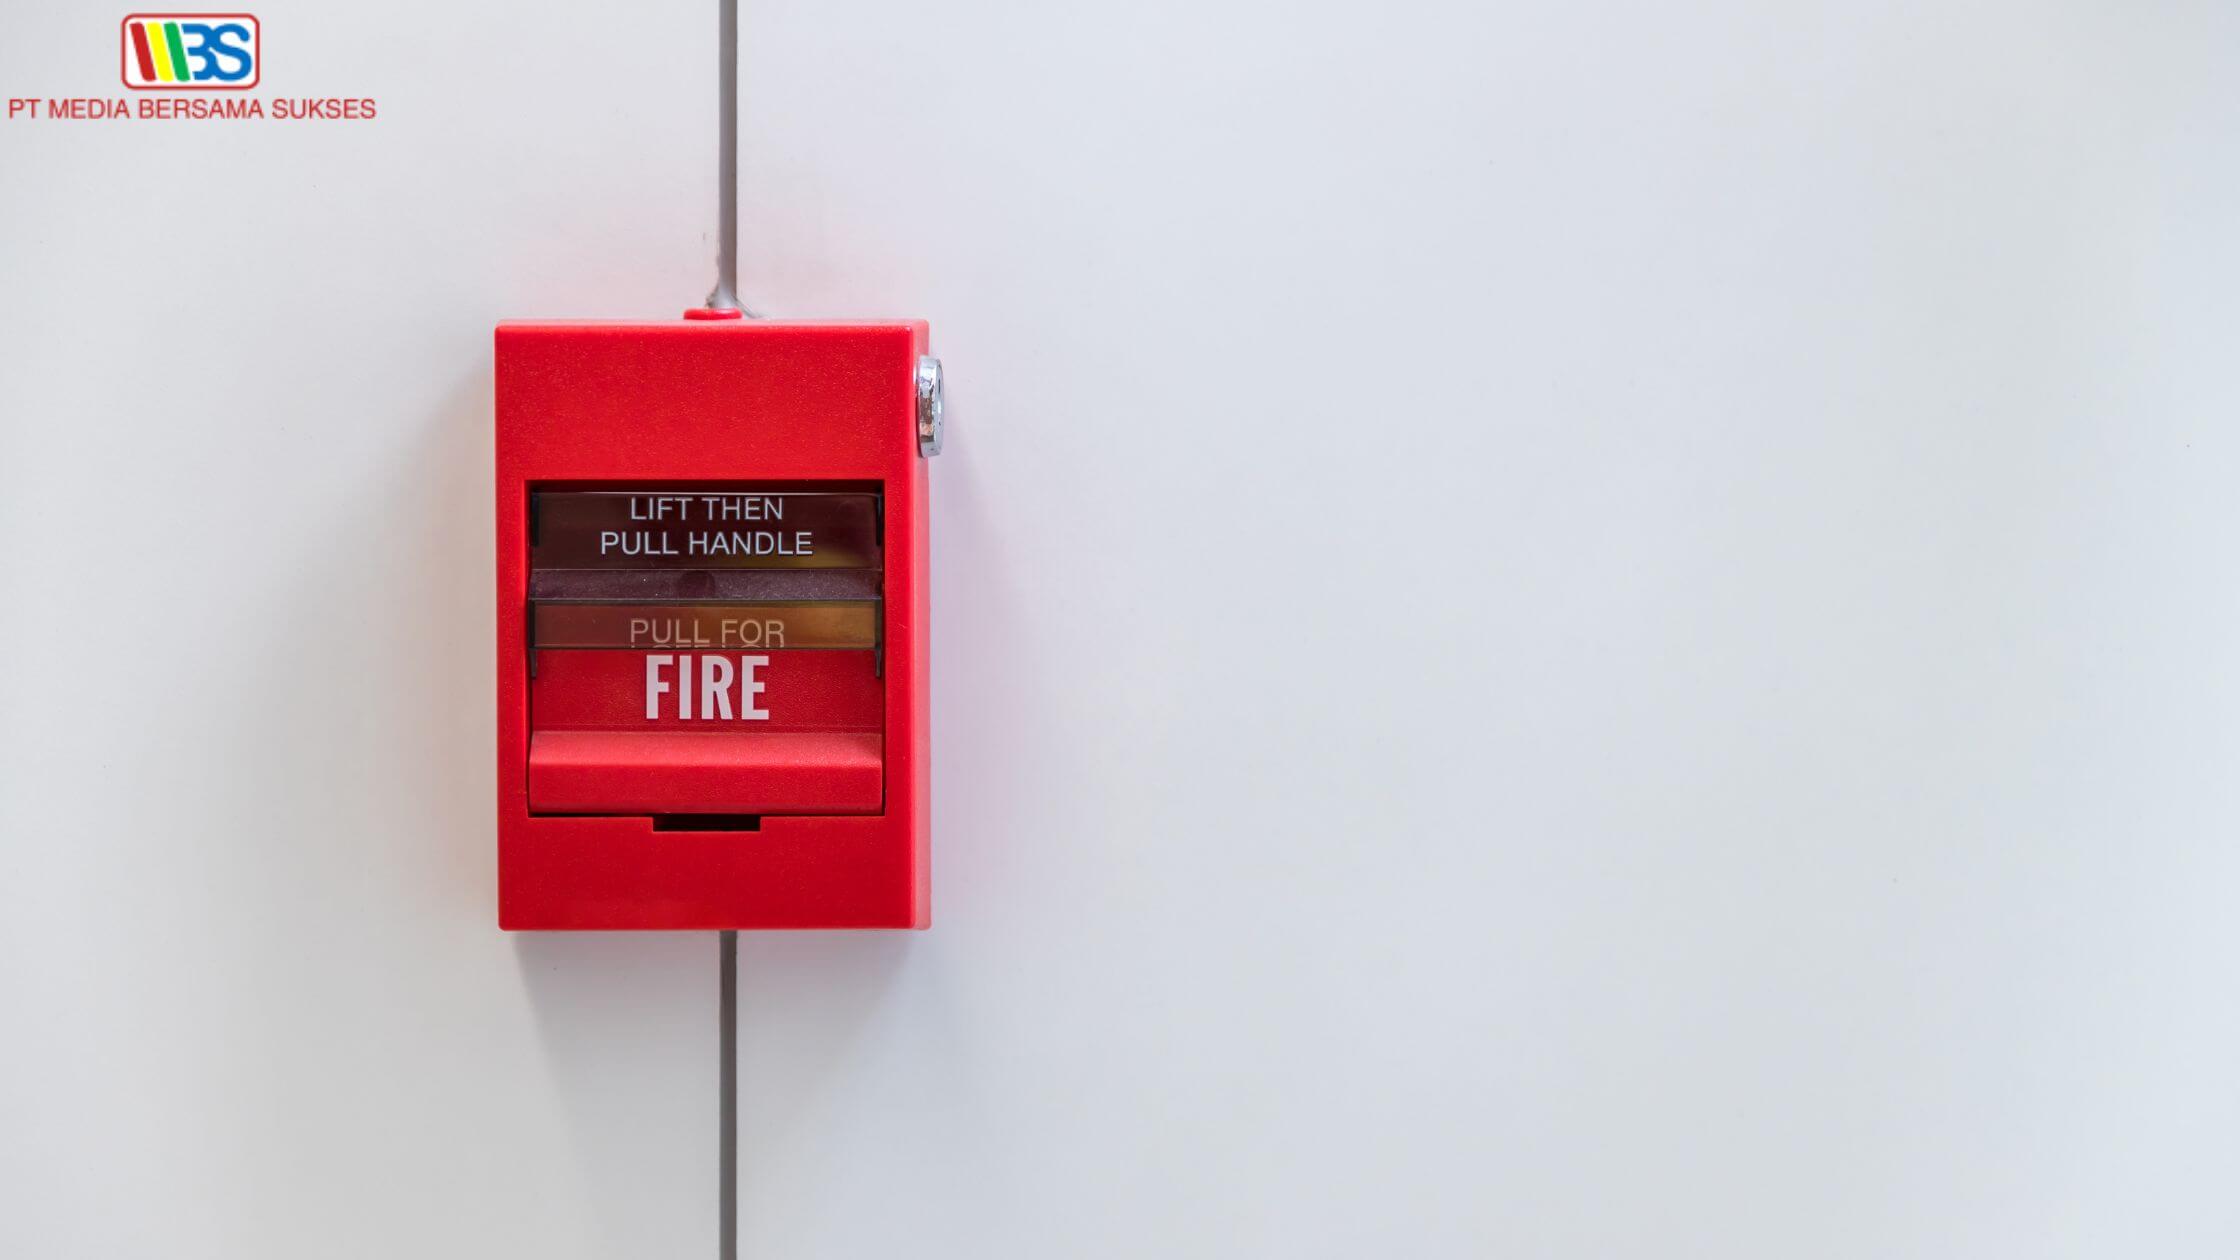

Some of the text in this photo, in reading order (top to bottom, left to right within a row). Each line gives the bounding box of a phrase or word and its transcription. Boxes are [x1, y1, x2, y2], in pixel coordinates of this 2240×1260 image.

[630, 497, 783, 520] LIFT THEN
[600, 531, 813, 555] PULL HANDLE
[630, 619, 785, 645] PULL FOR
[645, 654, 770, 720] FIRE
